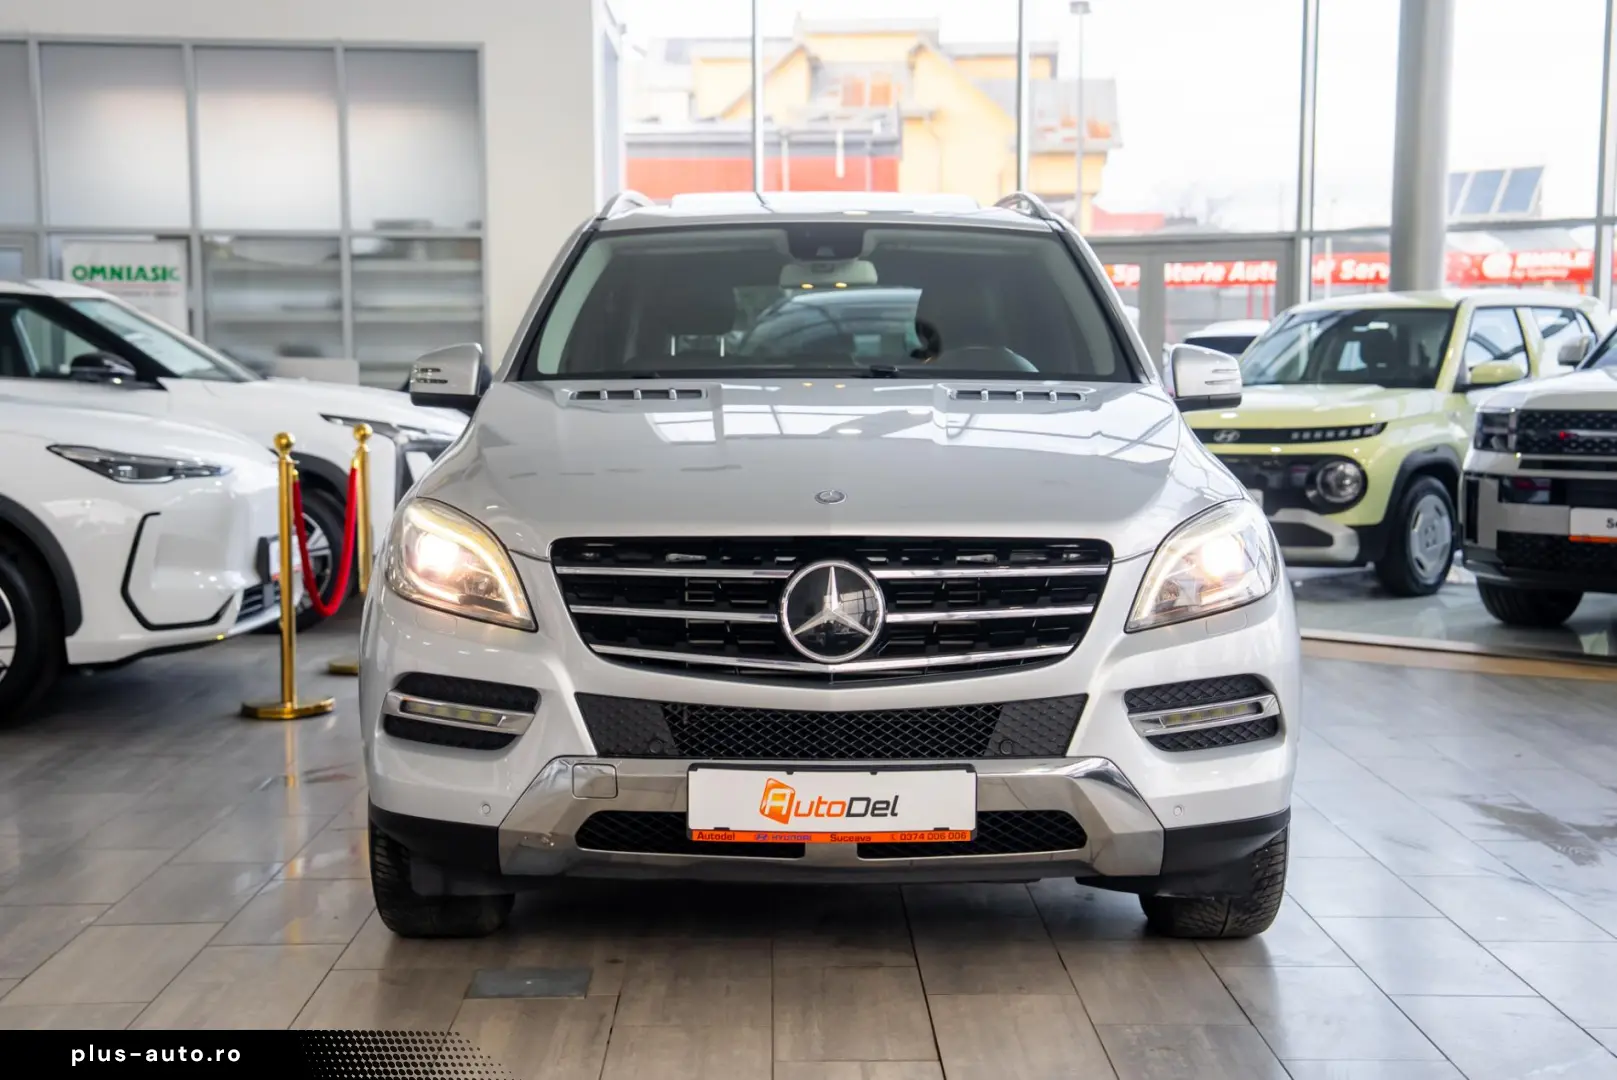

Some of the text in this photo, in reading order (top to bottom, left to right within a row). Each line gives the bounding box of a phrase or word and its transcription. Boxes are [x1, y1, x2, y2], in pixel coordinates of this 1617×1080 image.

[71, 264, 181, 281] OMNIASIC
[1606, 517, 1617, 529] S
[762, 786, 900, 820] AutoDel
[697, 831, 736, 841] Autodel
[830, 833, 872, 842] Suceava
[900, 832, 925, 841] 0374
[927, 832, 945, 840] 006
[948, 831, 967, 840] 006
